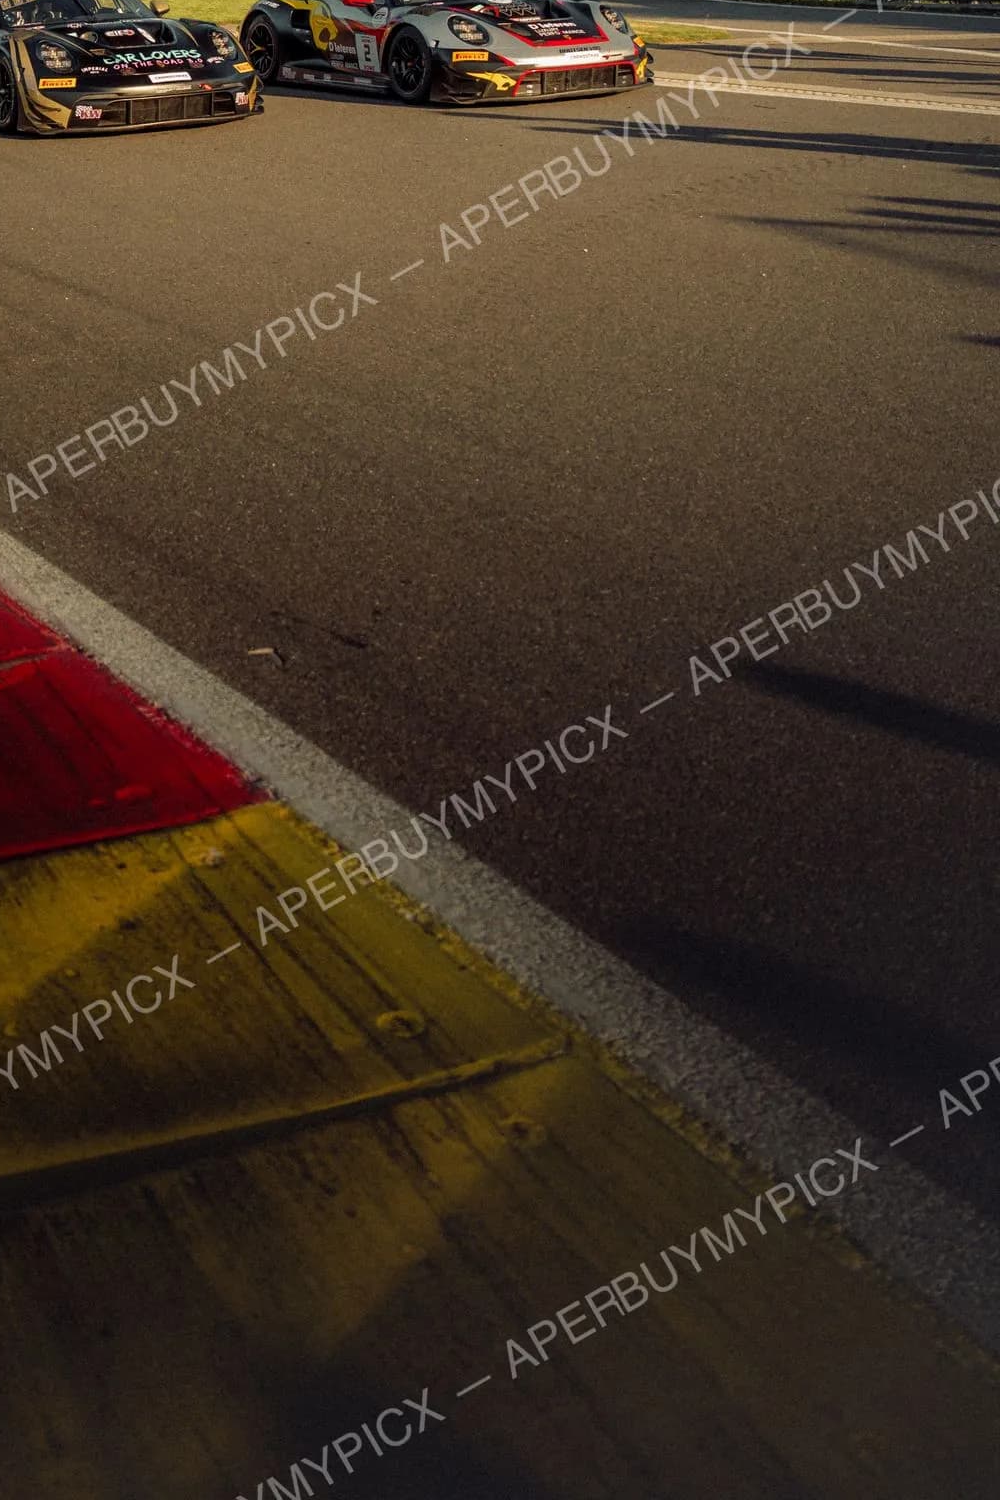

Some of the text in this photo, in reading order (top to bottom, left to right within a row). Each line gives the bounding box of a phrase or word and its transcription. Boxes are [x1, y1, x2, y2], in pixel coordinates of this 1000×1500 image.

[142, 50, 202, 62] LOVERS
[454, 53, 487, 61] PIRELLI
[133, 61, 153, 69] THE
[41, 80, 74, 88] PIRELLI
